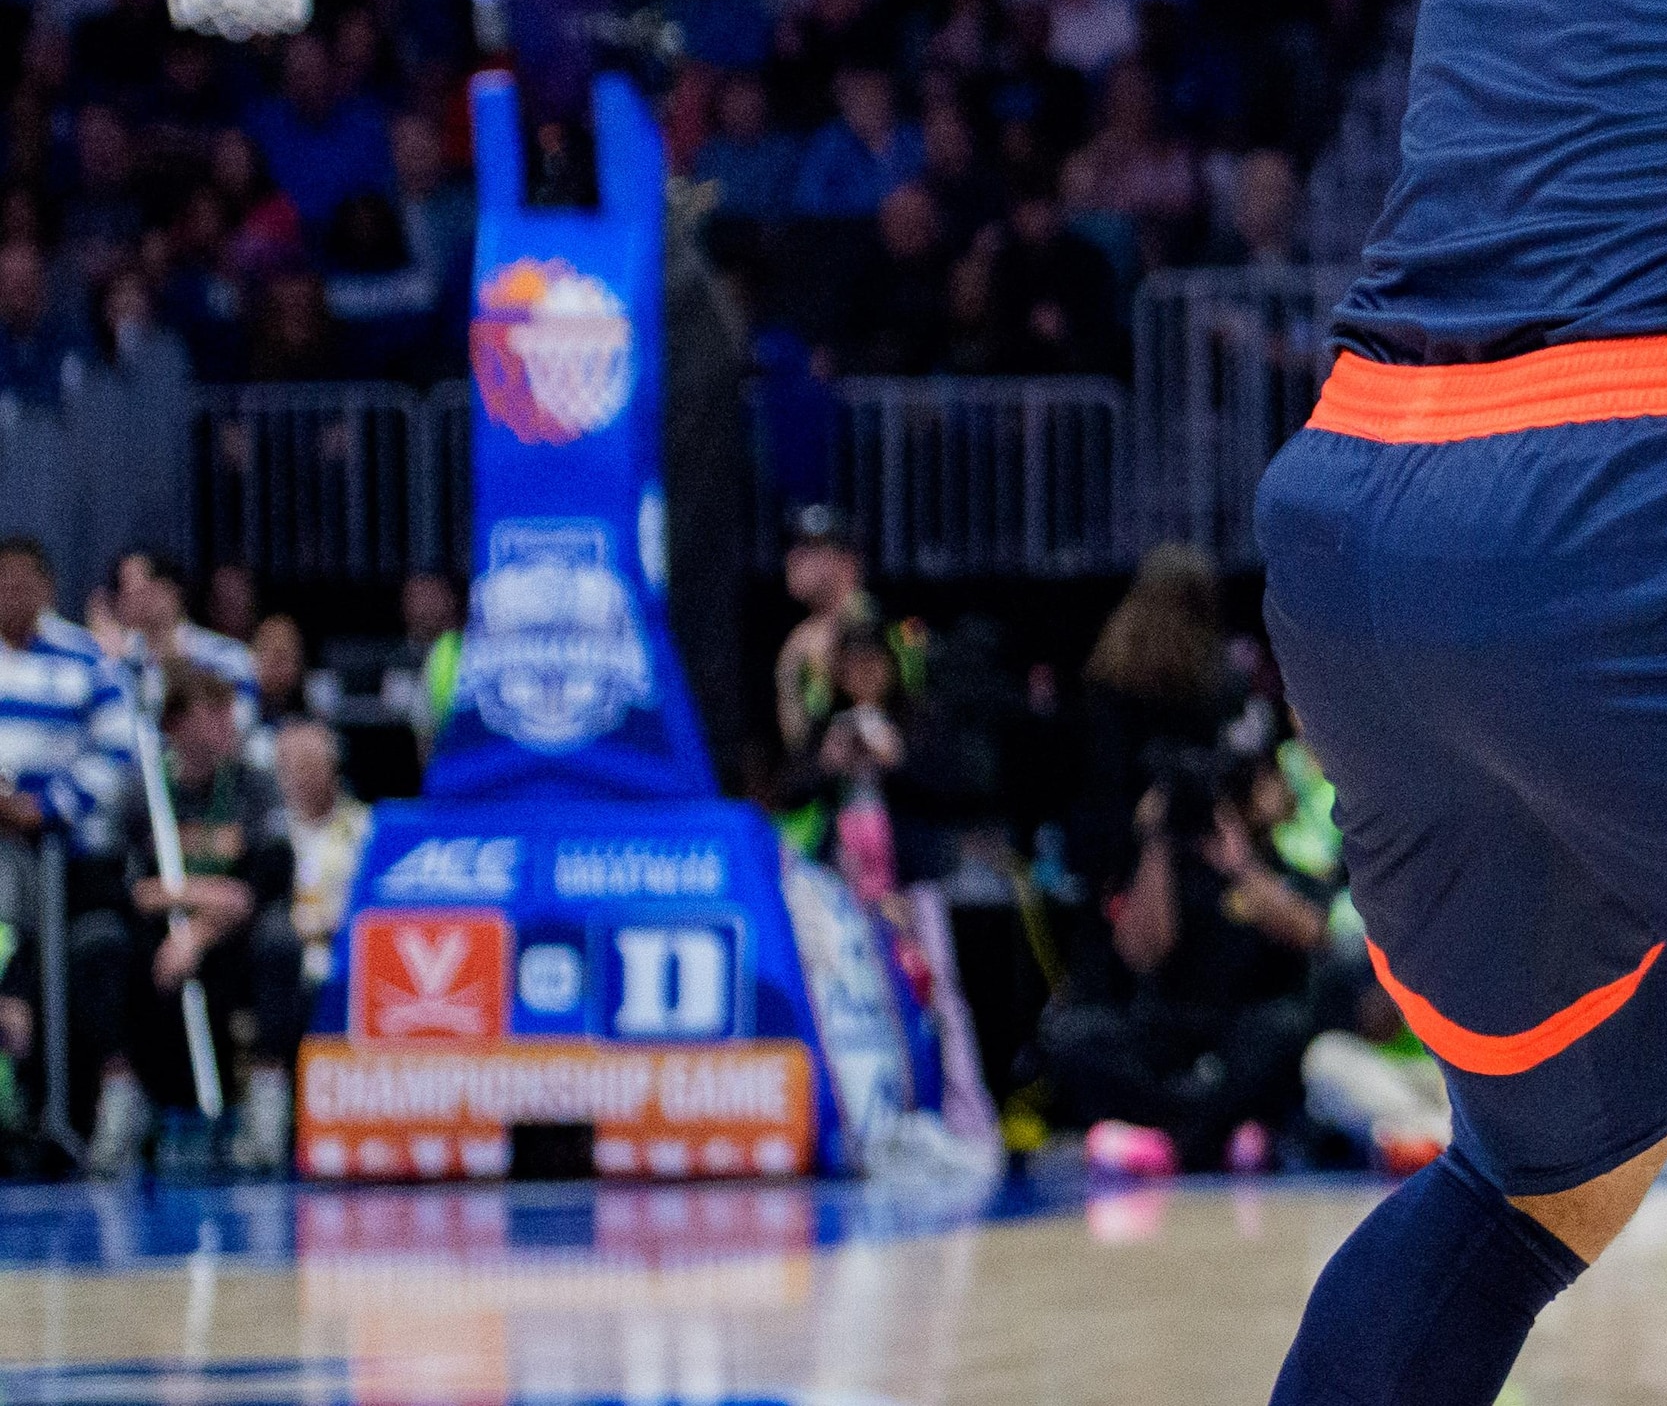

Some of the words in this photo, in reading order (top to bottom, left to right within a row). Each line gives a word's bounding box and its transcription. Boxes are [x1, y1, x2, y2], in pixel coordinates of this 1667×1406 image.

[614, 926, 732, 1034] D
[304, 1053, 652, 1122] CHAMPIONSHIP
[660, 1054, 790, 1124] GAME
